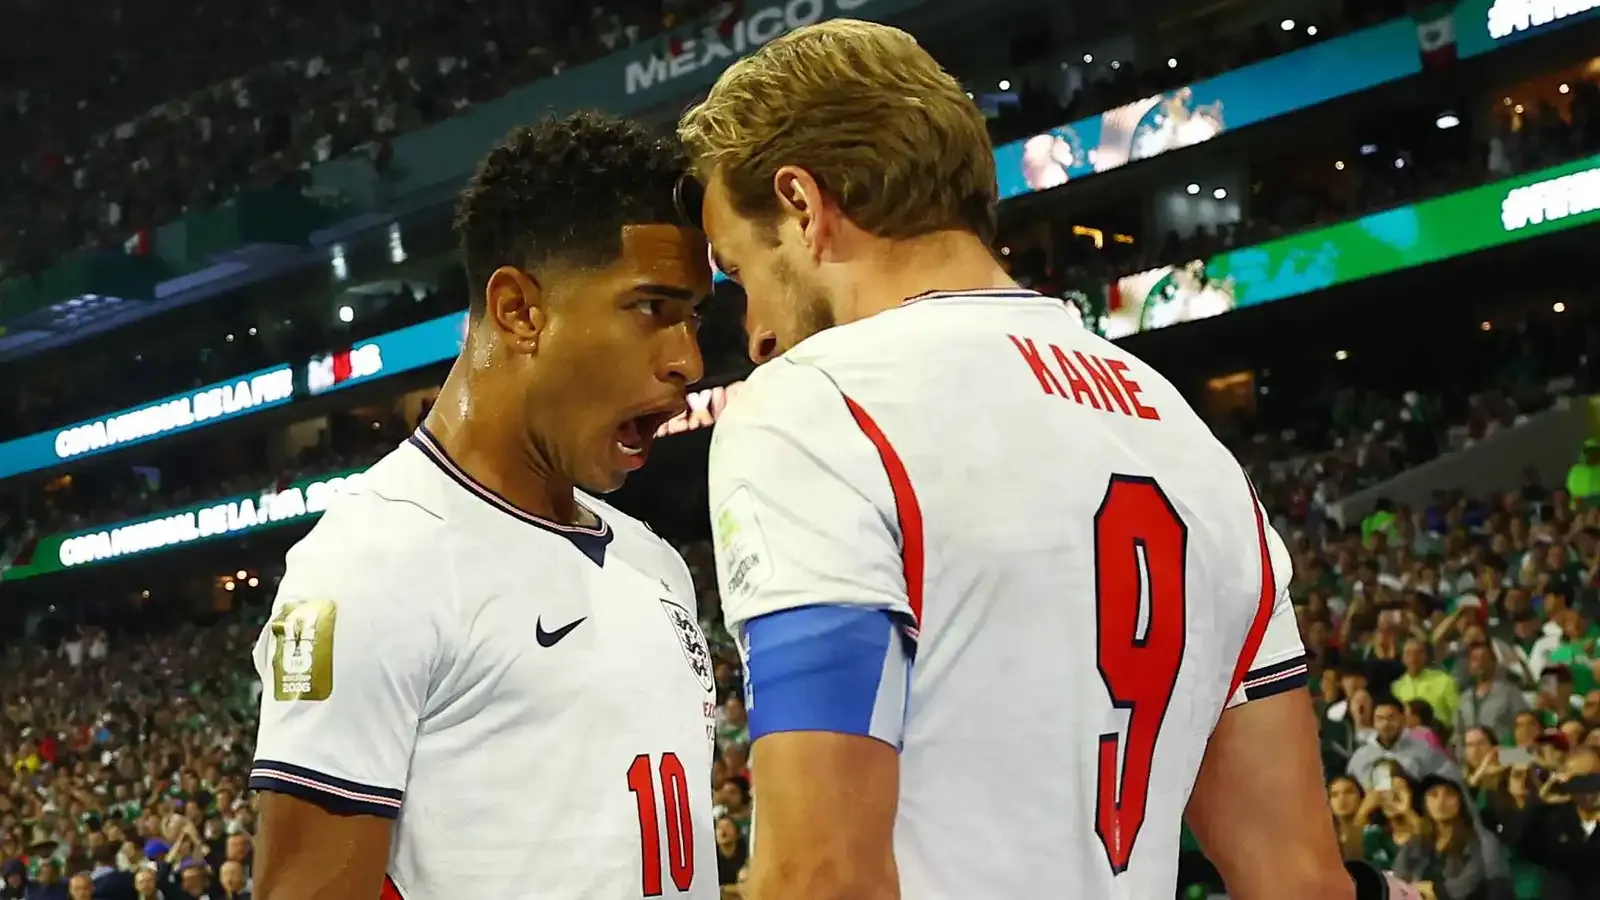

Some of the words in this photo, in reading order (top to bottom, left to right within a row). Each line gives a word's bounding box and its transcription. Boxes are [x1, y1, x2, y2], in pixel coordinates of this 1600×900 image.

[626, 0, 824, 94] MEXICO
[55, 421, 108, 458] COPA
[106, 397, 195, 446] MUNDIAL
[193, 388, 223, 421] DE
[223, 381, 253, 413] LA
[1007, 334, 1161, 421] KANE
[59, 530, 113, 566] COPA
[110, 512, 200, 557] MUNDIAL
[199, 504, 228, 537] DE
[228, 498, 258, 530] LA
[1094, 473, 1188, 877] 9
[627, 752, 694, 897] 10
